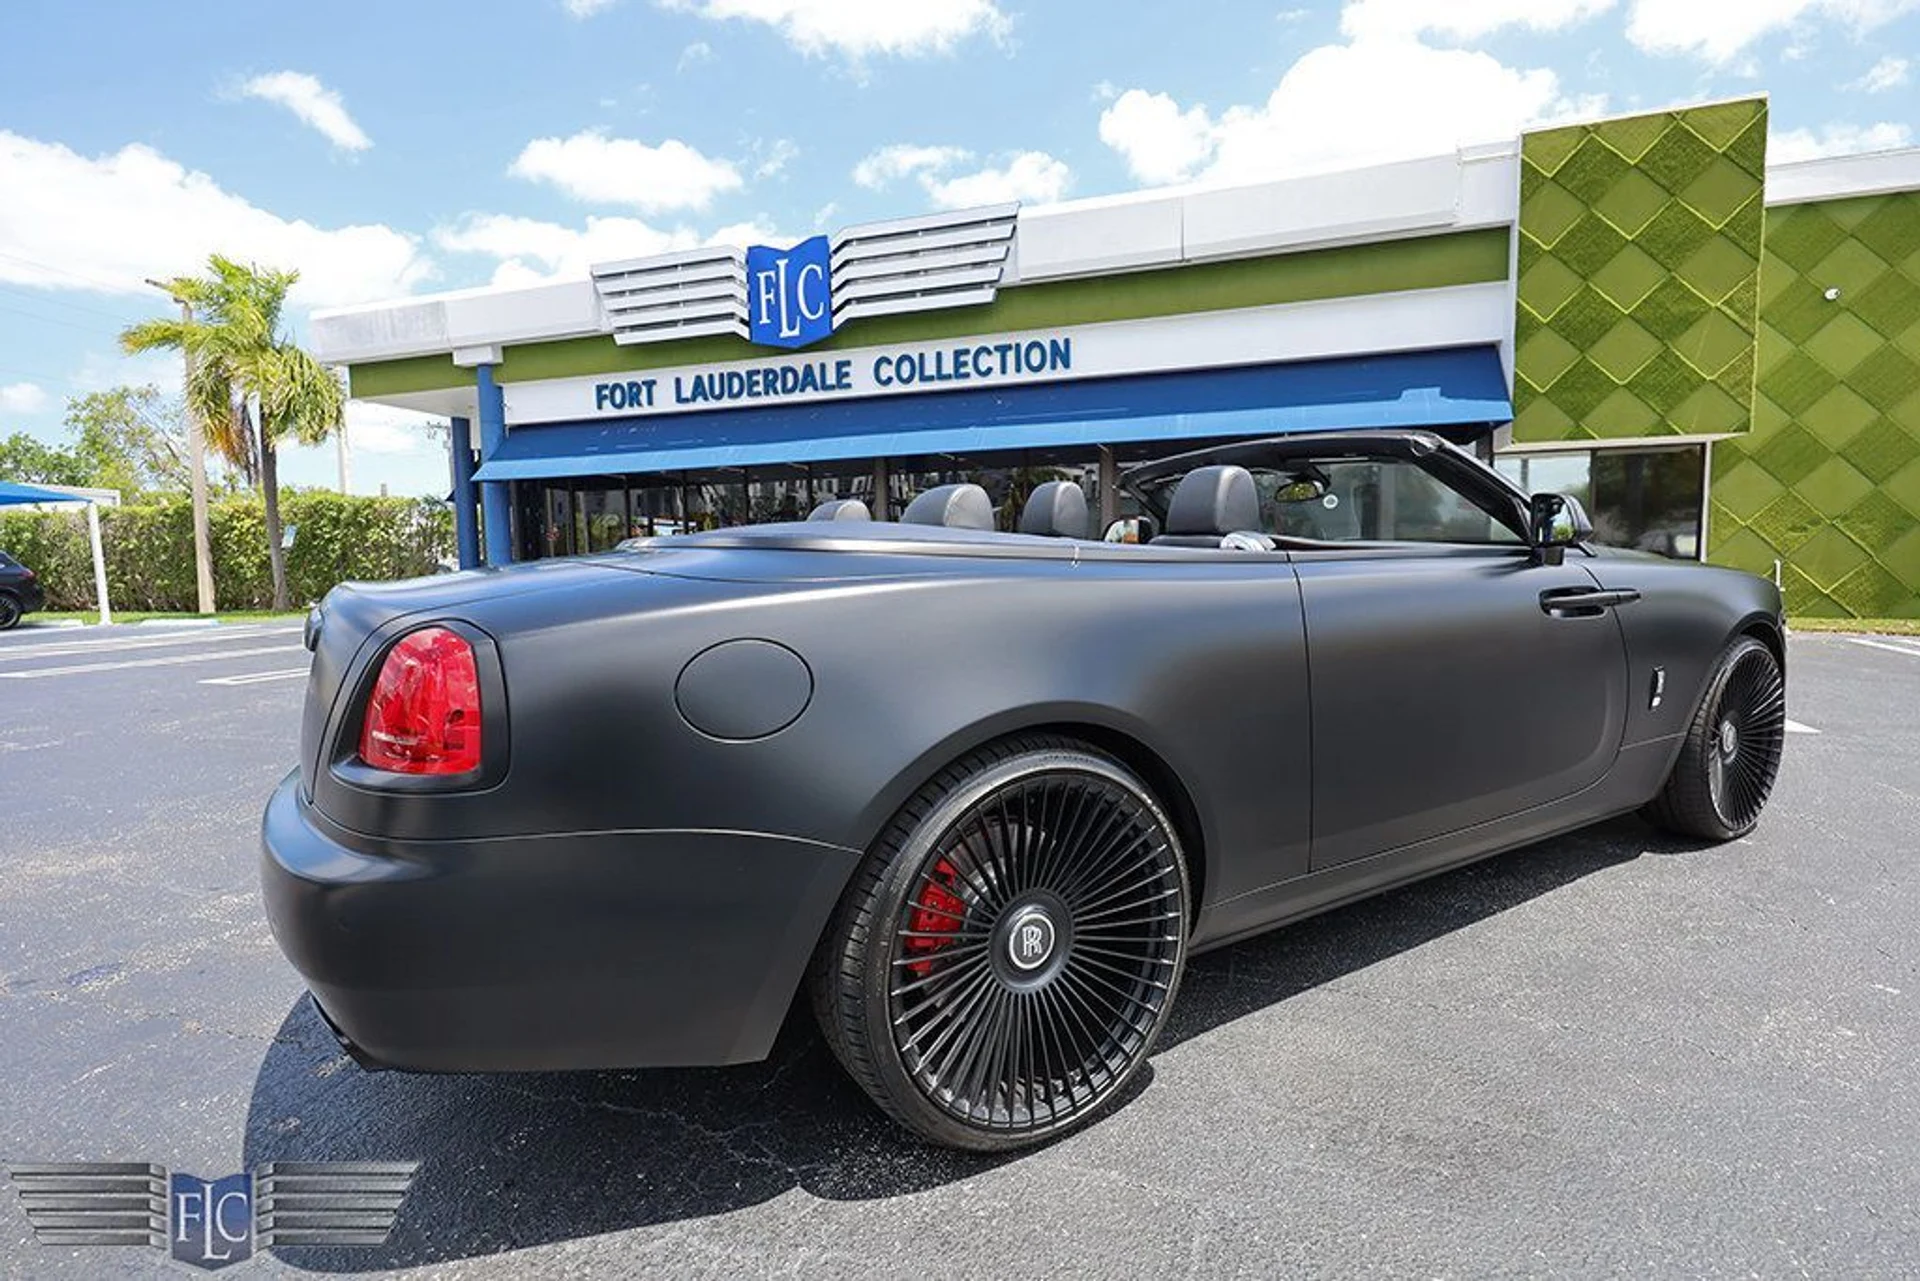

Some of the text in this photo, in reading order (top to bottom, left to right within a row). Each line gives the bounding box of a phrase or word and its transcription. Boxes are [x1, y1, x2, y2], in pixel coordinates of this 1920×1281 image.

[757, 258, 824, 338] FLC
[596, 338, 1071, 411] FORT LAUDERDALE COLLECTION
